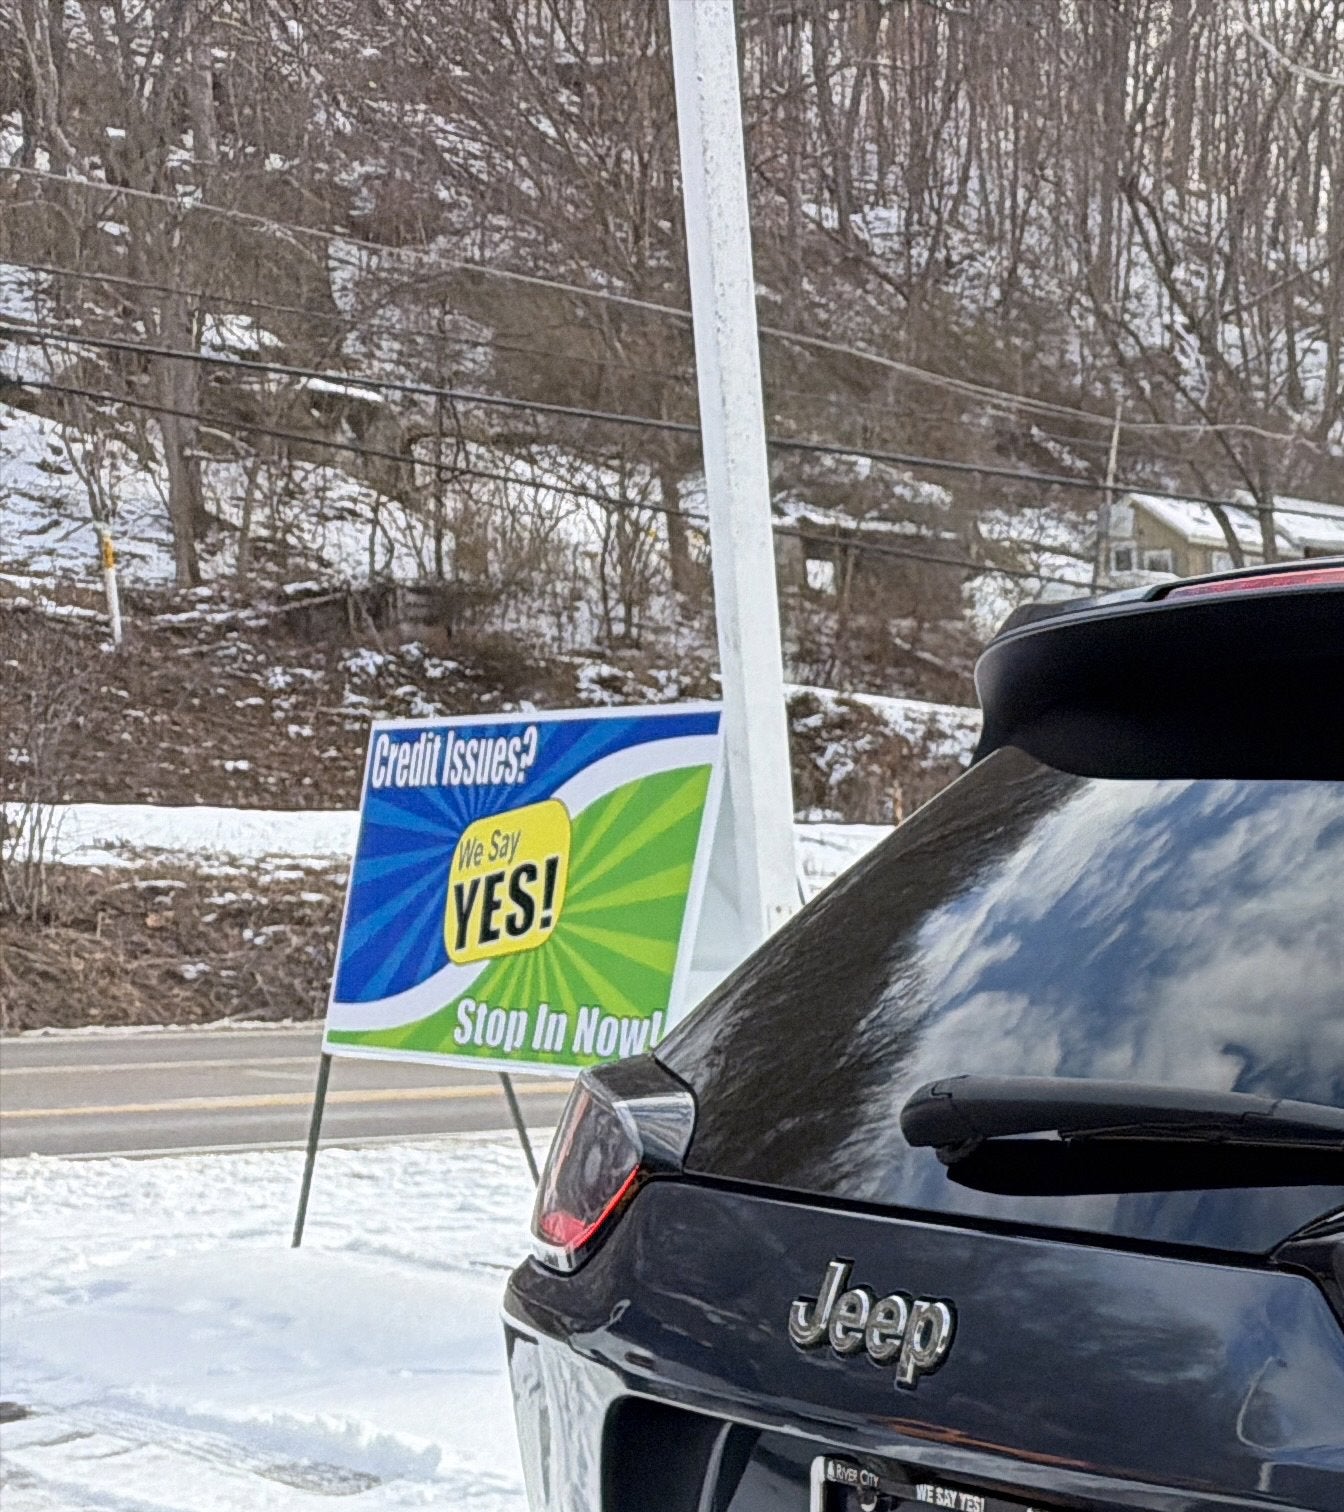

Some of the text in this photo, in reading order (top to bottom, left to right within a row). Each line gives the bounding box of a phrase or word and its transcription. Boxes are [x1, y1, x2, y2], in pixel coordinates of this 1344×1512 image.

[372, 725, 539, 789] Credit Issues?
[459, 829, 521, 872] We Say
[454, 856, 560, 952] YES!
[454, 999, 664, 1058] Stop In Now!
[788, 1257, 957, 1389] Jeep
[859, 1469, 880, 1487] CITY
[916, 1484, 934, 1503] WE
[935, 1488, 957, 1509] SAY
